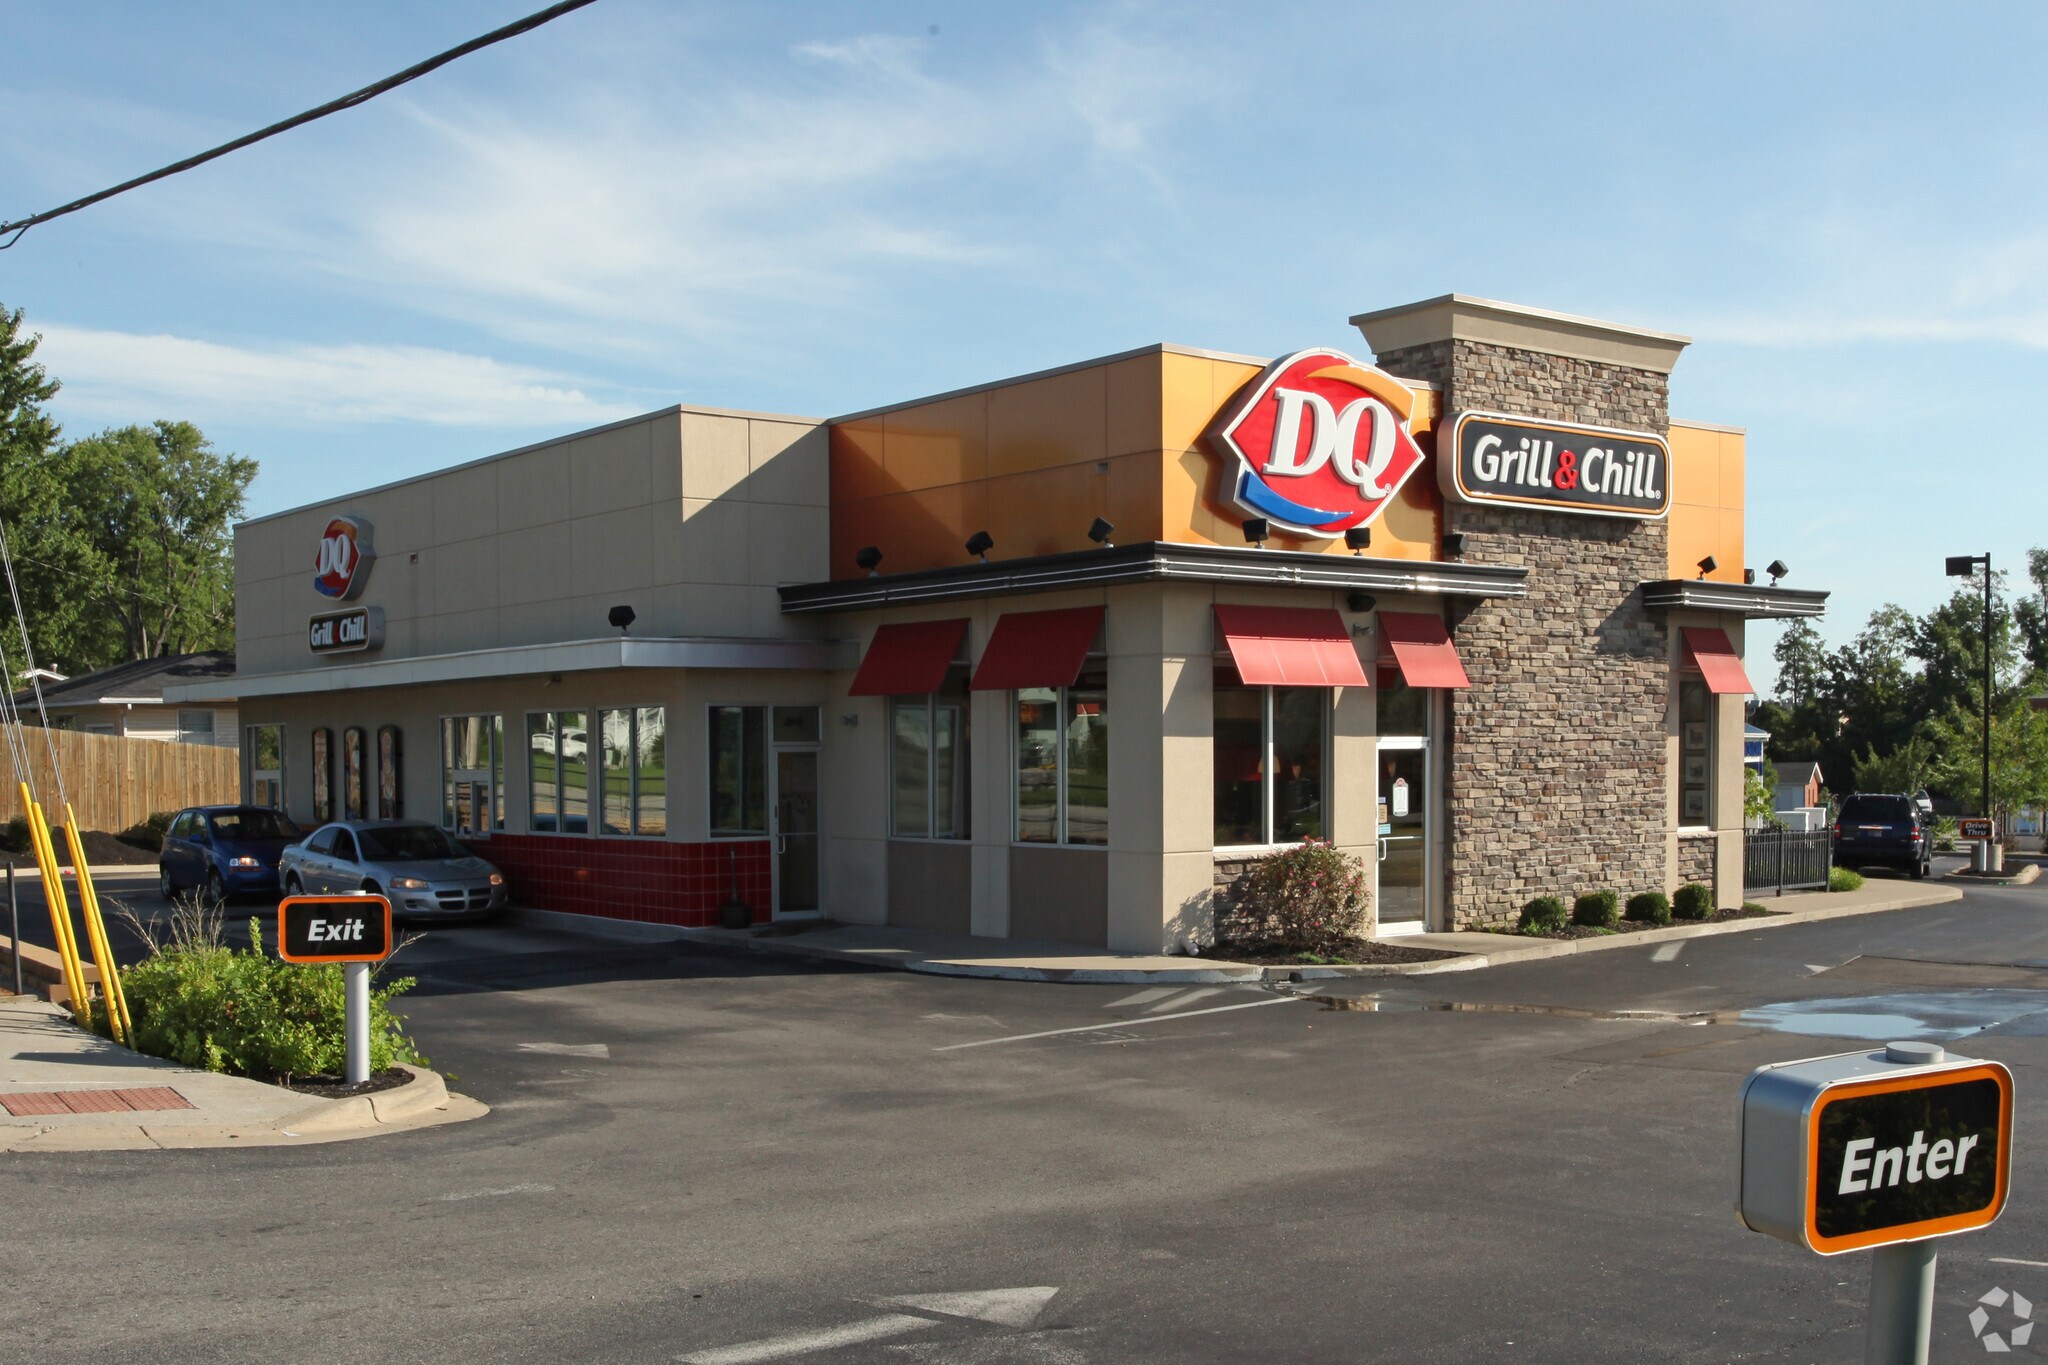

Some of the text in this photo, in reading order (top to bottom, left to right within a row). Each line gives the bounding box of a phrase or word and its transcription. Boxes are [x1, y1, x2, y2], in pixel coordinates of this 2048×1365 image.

[1262, 387, 1387, 501] DQ
[319, 534, 351, 579] DQ
[307, 918, 364, 941] Exit
[1838, 1130, 1979, 1195] Enter
